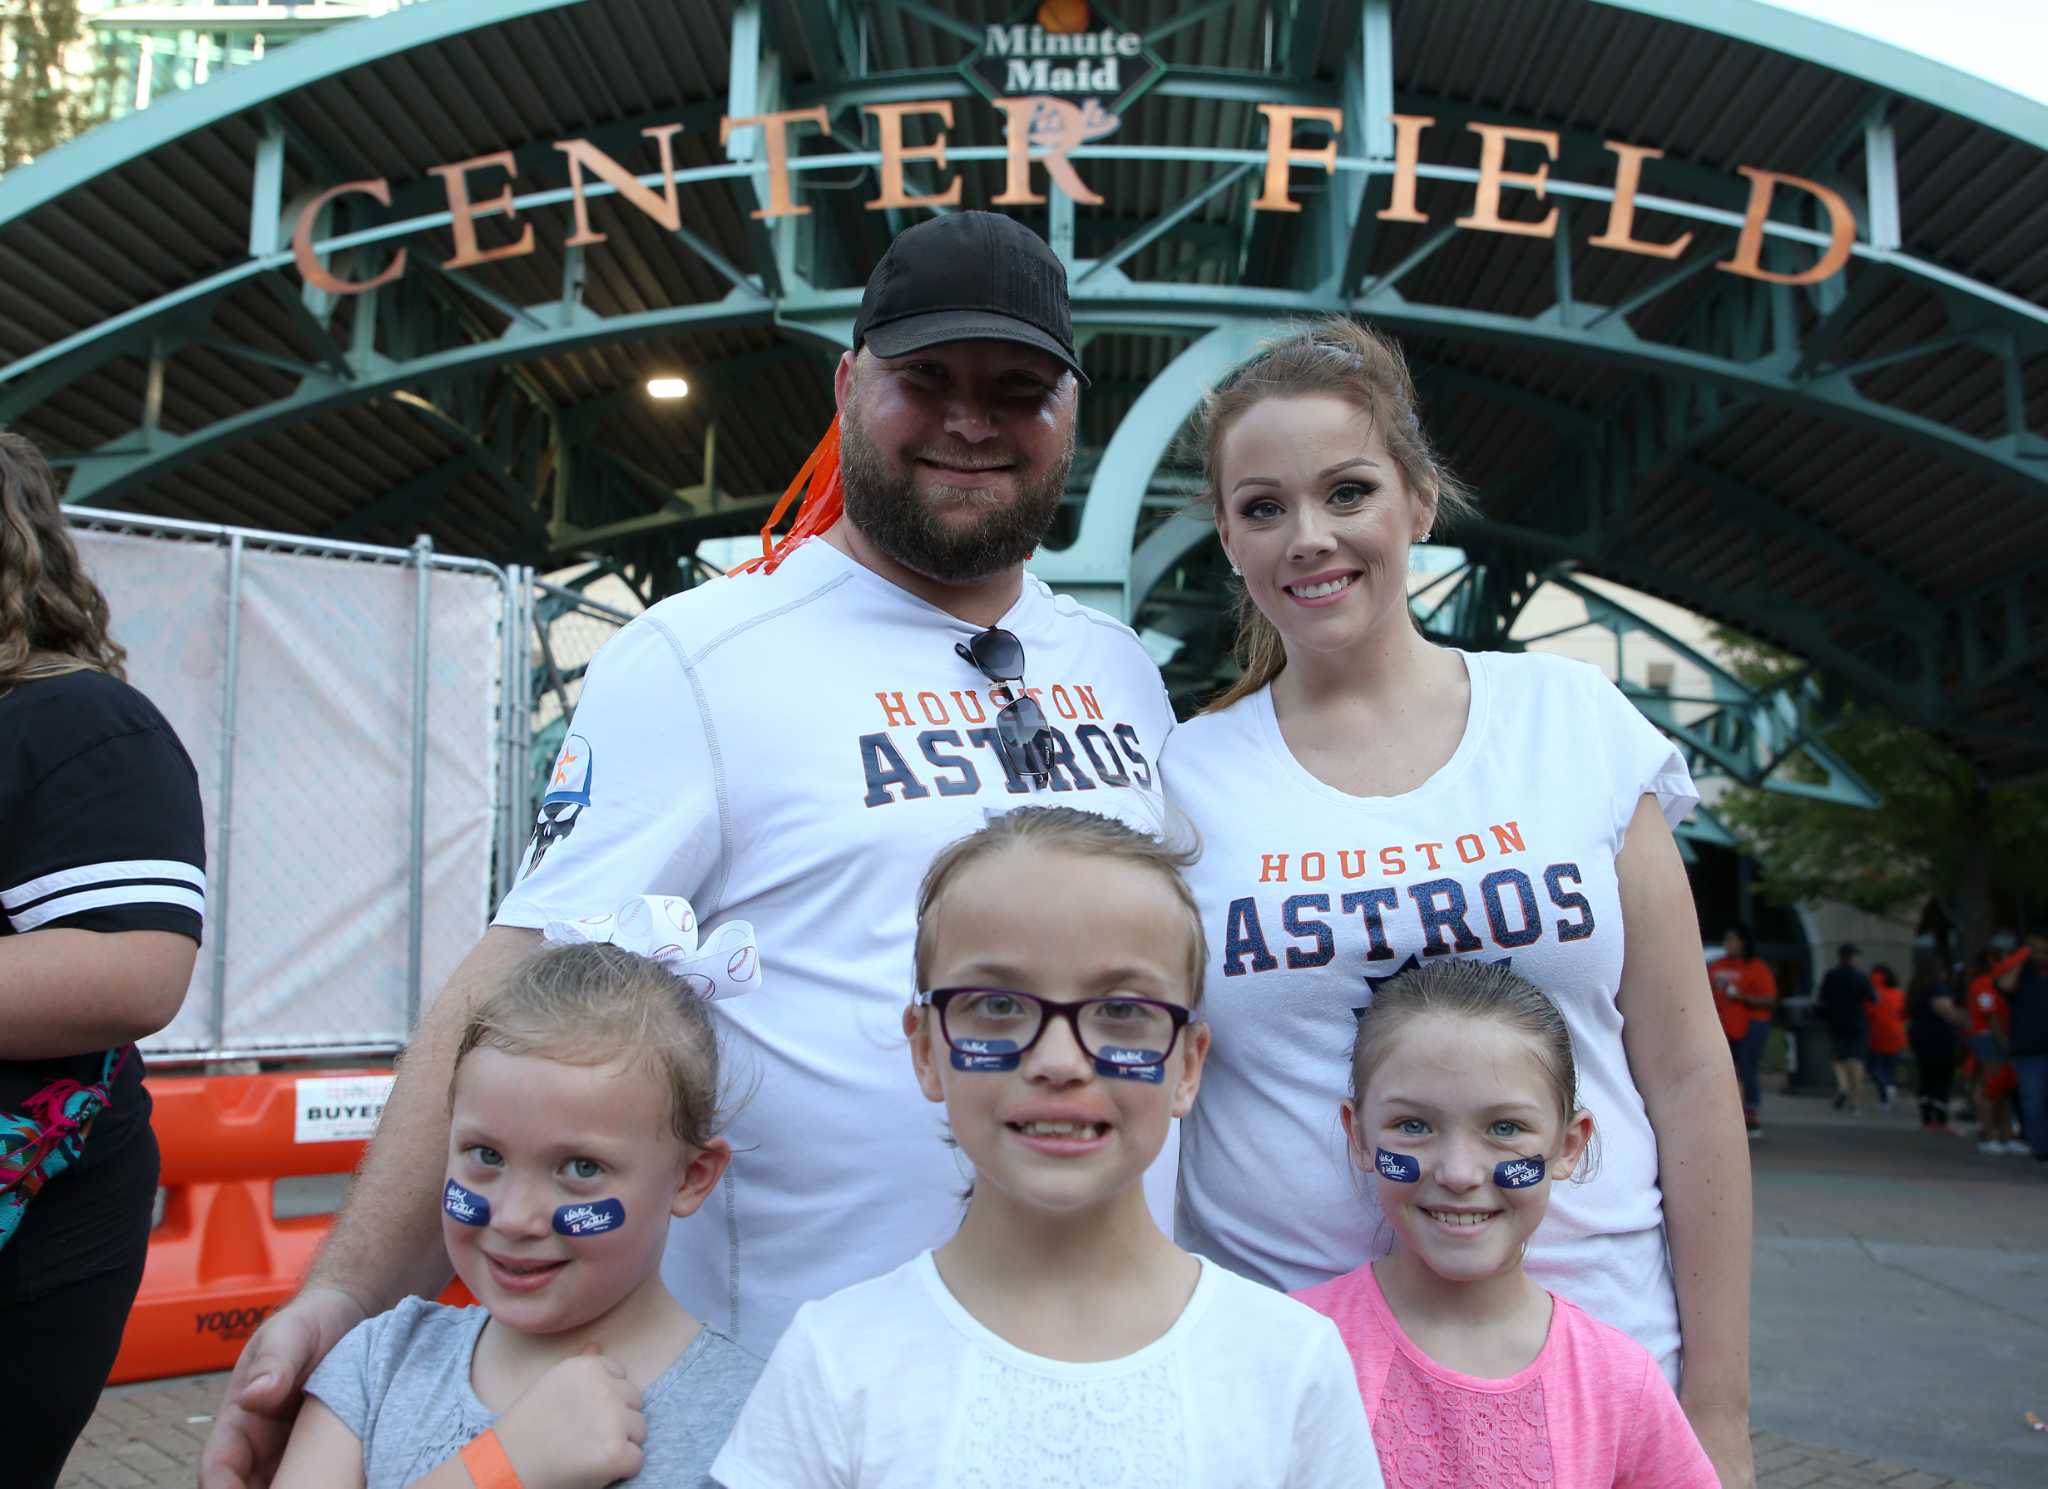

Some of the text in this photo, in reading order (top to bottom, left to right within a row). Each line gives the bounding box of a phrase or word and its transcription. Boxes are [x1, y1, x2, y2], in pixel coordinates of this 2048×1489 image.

[984, 23, 1142, 56] Minute
[1004, 57, 1120, 92] Maid
[293, 97, 1857, 296] CENTER FIELD
[859, 723, 1152, 808] ASTROS
[1258, 821, 1527, 883] HOUSTON
[1223, 862, 1596, 978] ASTROS
